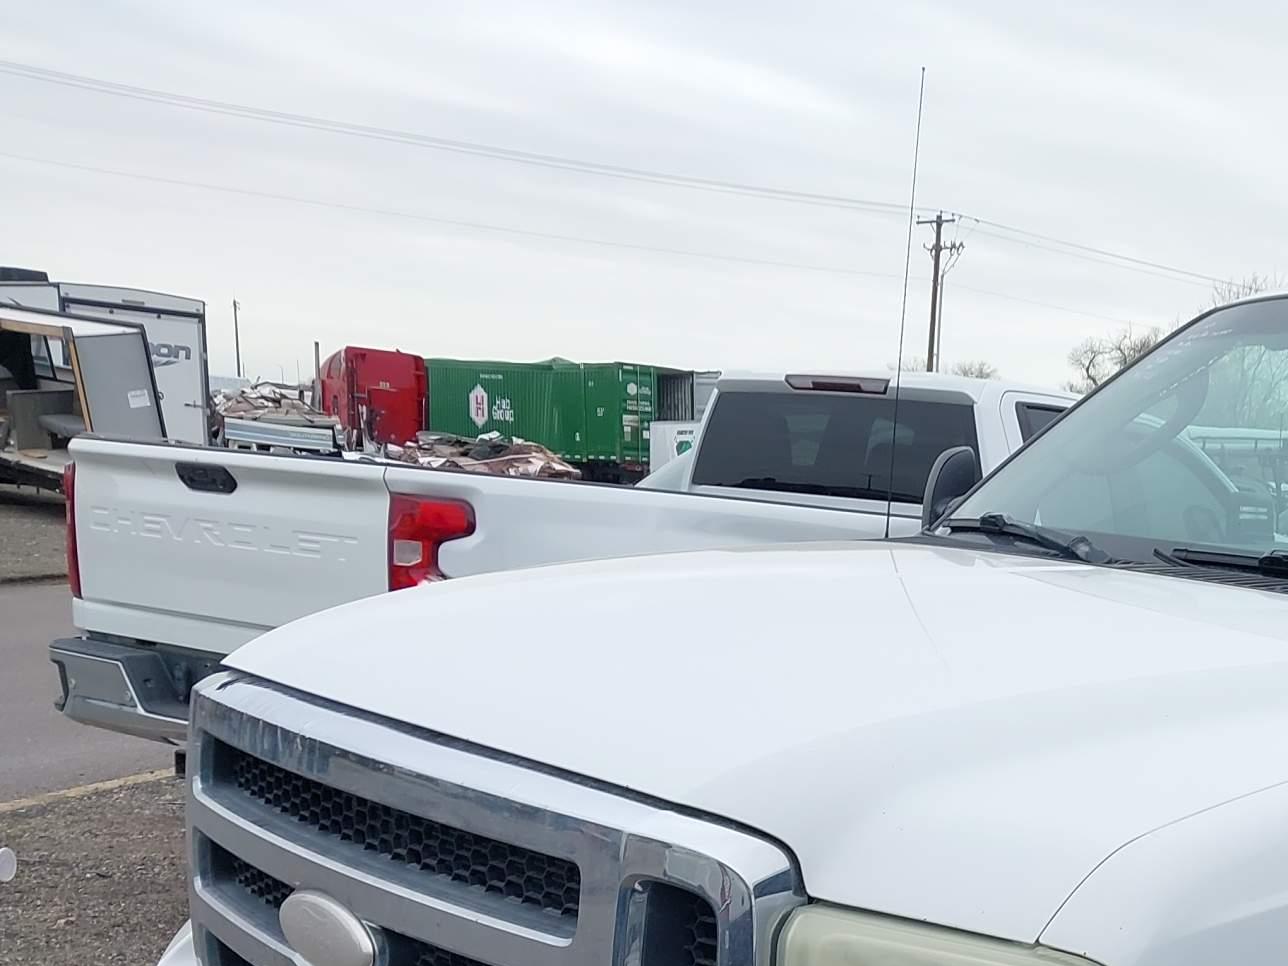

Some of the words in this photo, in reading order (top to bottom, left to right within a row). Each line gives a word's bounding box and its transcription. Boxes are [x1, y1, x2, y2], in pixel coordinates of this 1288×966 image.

[495, 395, 511, 411] Hub
[491, 405, 514, 424] Group
[89, 505, 359, 562] CHEVROLET
